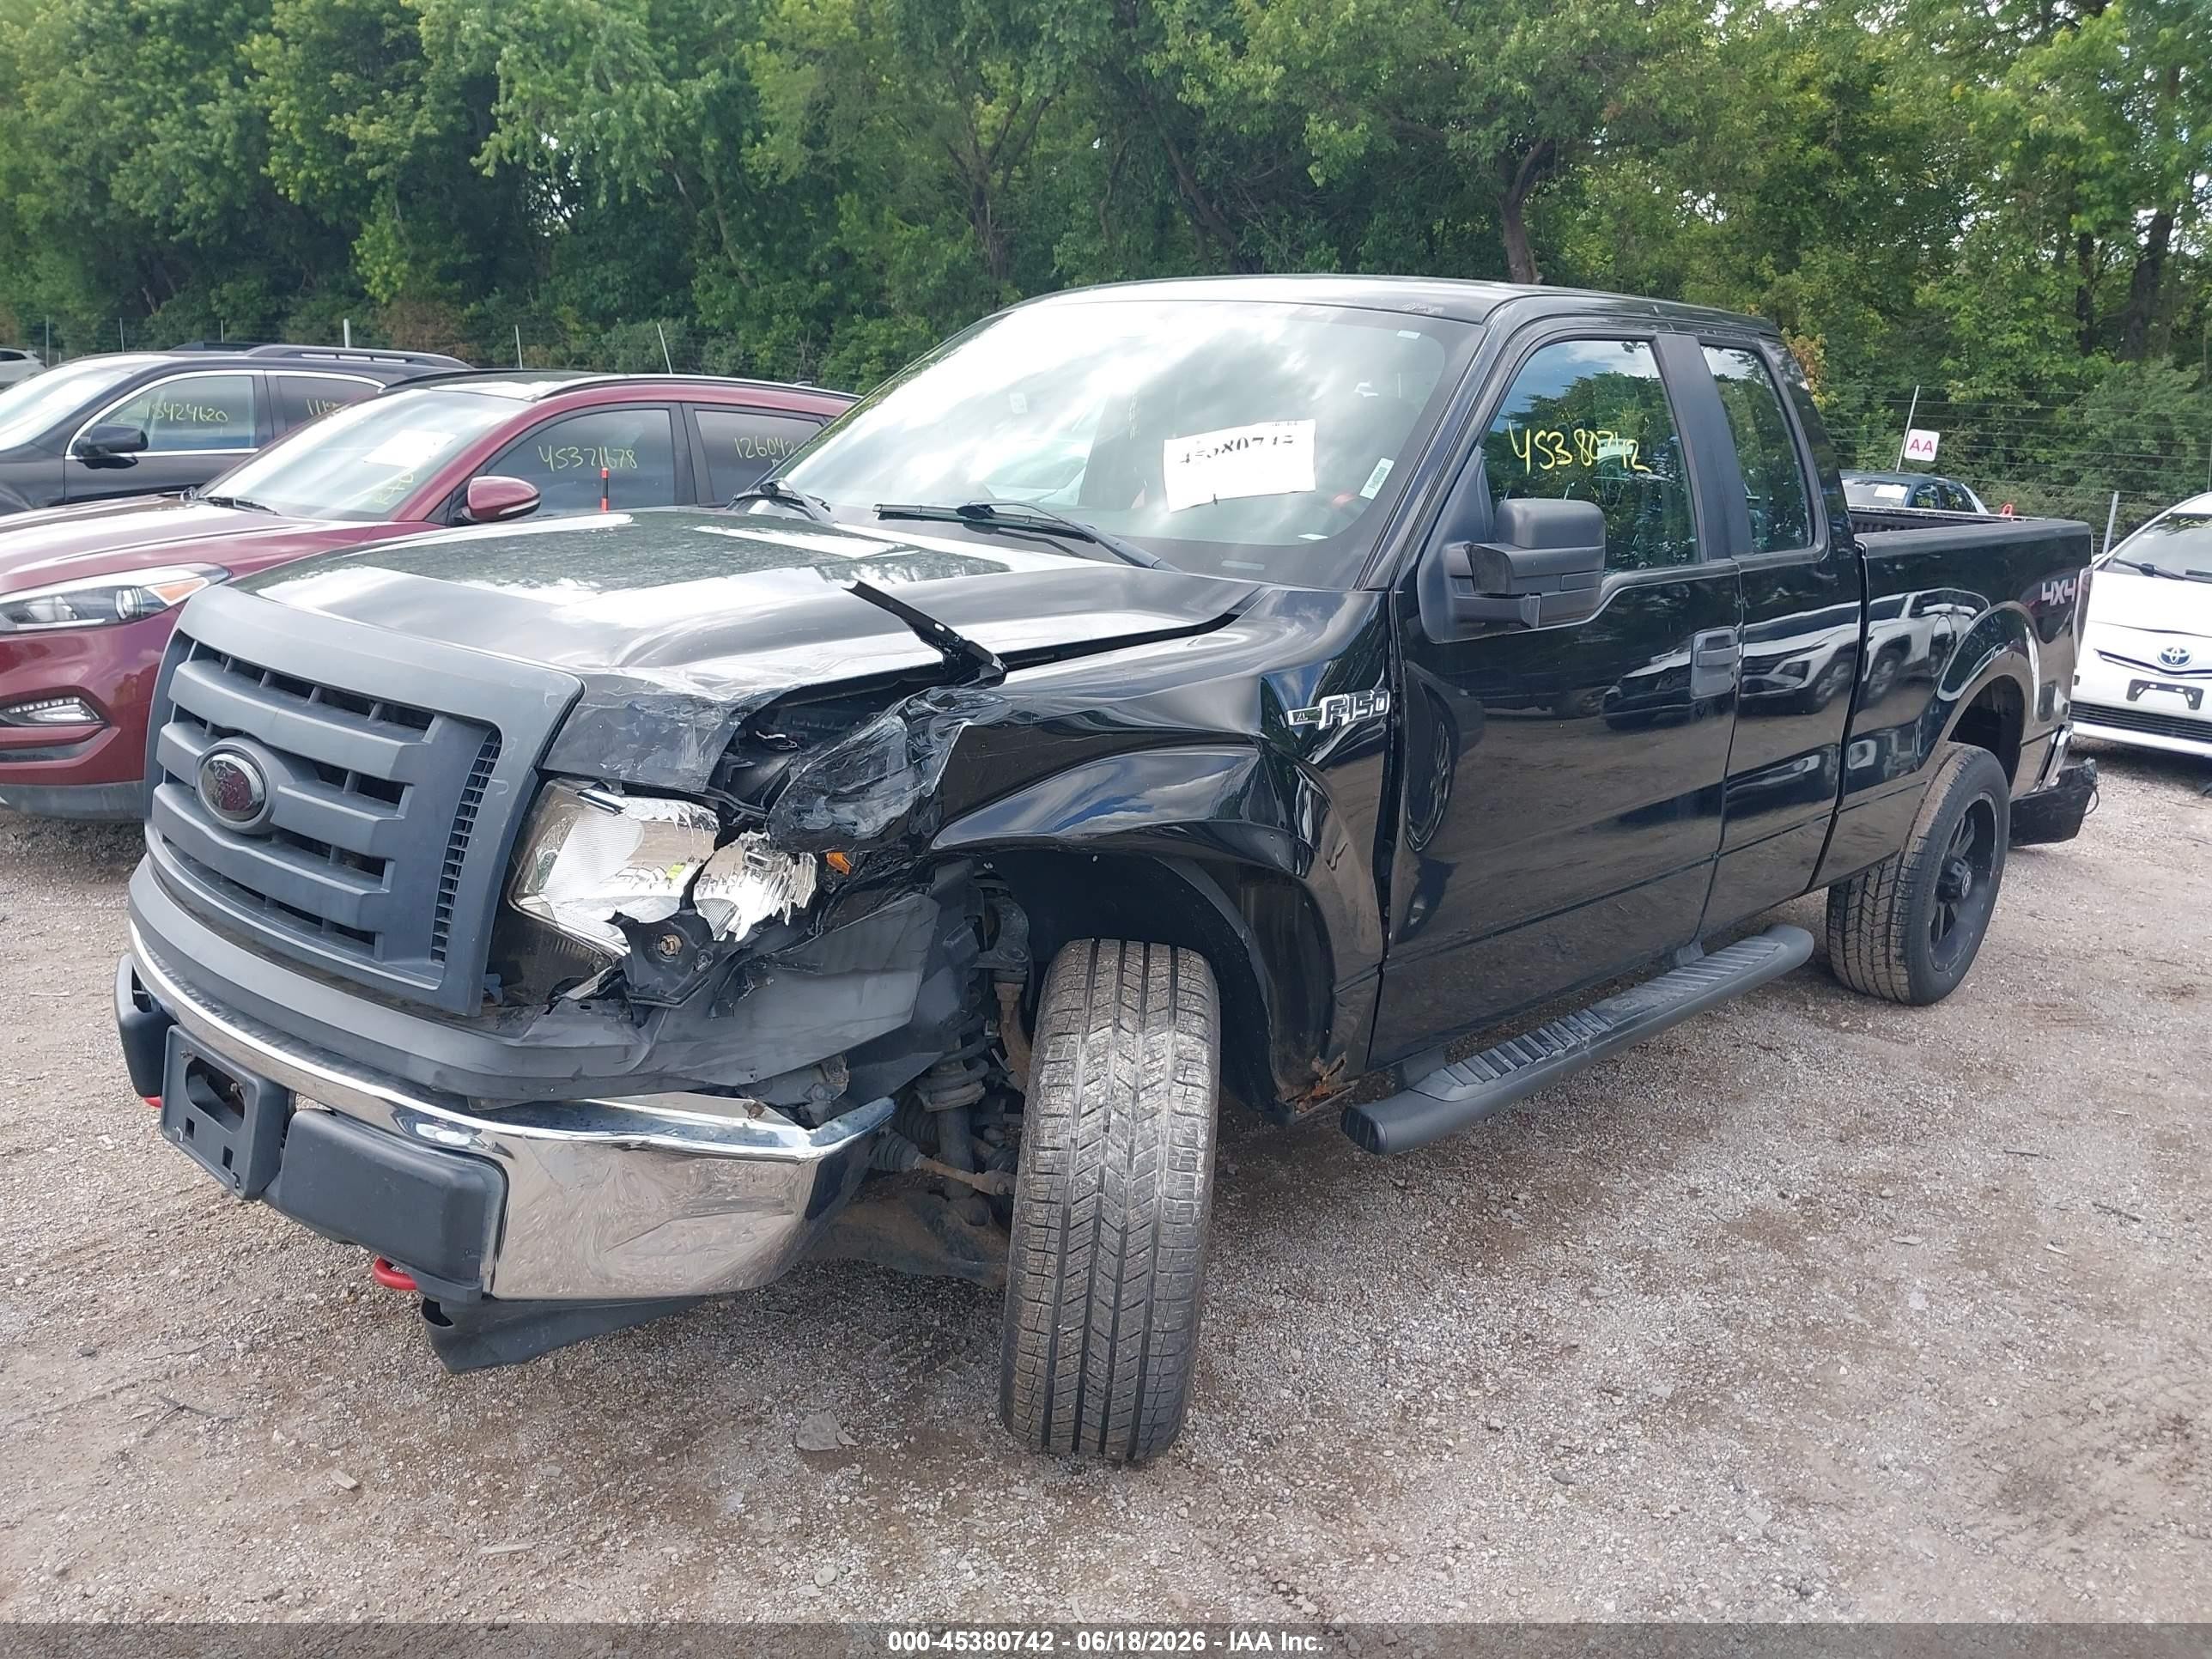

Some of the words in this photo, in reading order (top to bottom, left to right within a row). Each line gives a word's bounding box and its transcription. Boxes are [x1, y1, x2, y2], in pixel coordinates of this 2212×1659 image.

[538, 445, 638, 471] 45371678
[1508, 419, 1653, 476] 45380742
[1909, 439, 1934, 453] AA
